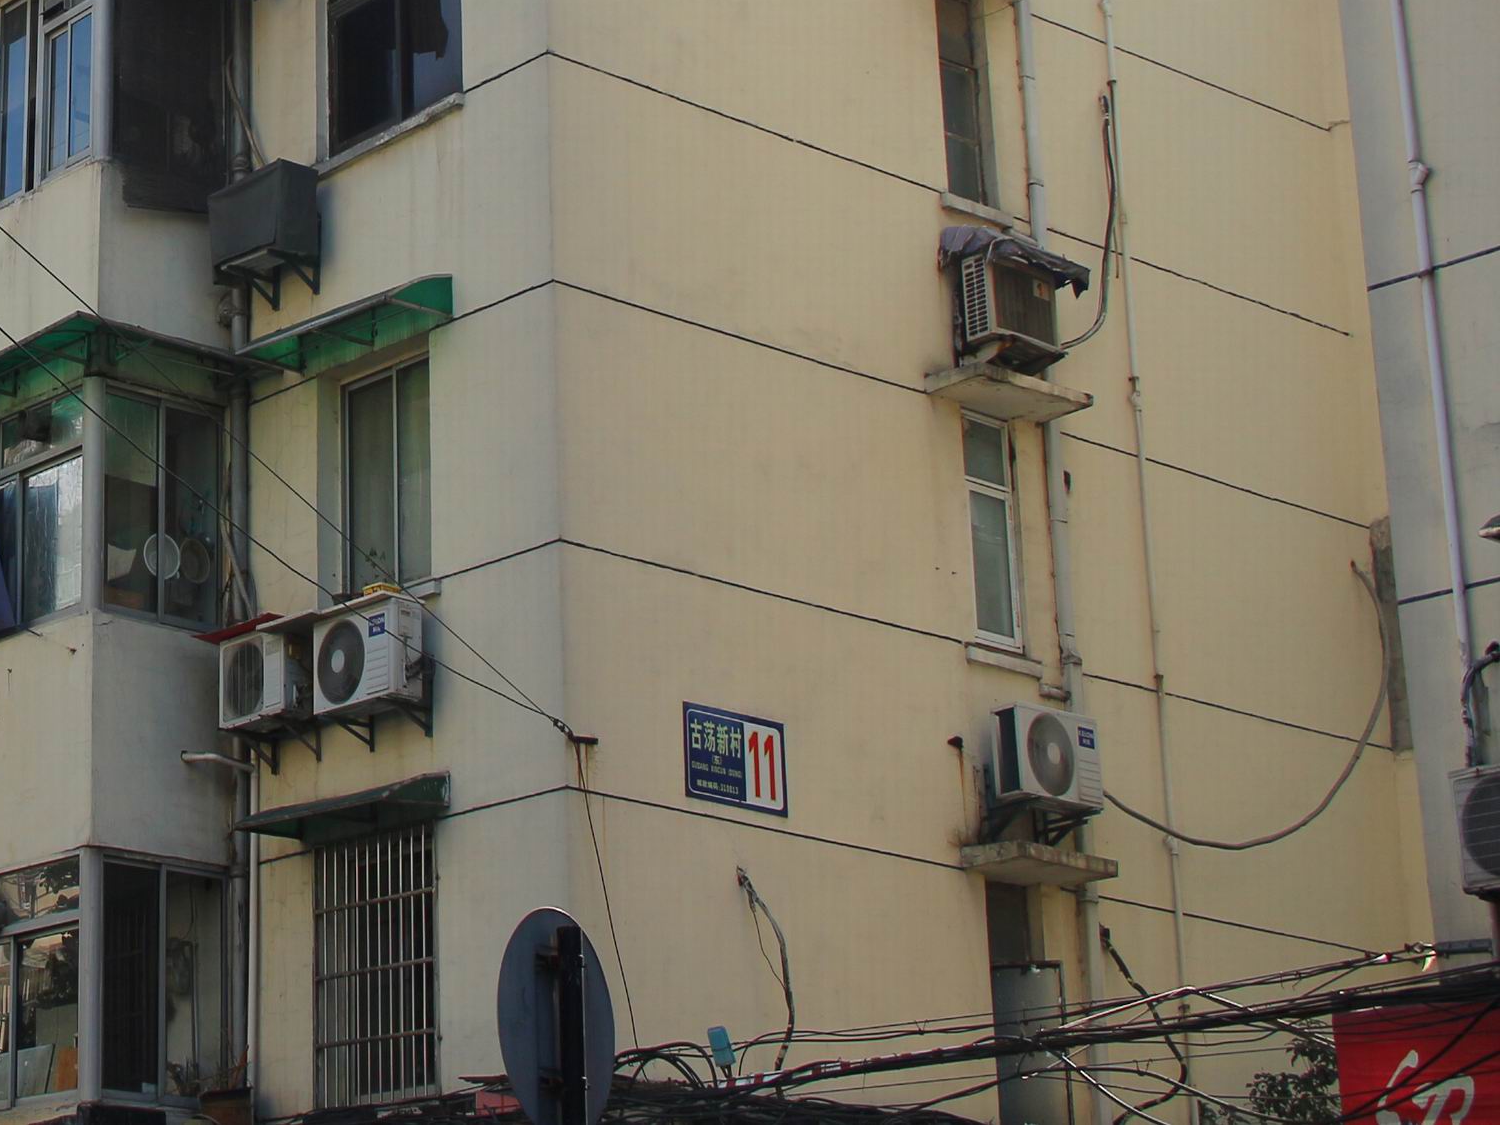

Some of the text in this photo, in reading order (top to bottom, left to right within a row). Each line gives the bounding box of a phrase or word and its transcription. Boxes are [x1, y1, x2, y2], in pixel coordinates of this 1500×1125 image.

[690, 719, 741, 758] 古荡新村
[748, 731, 776, 801] 11
